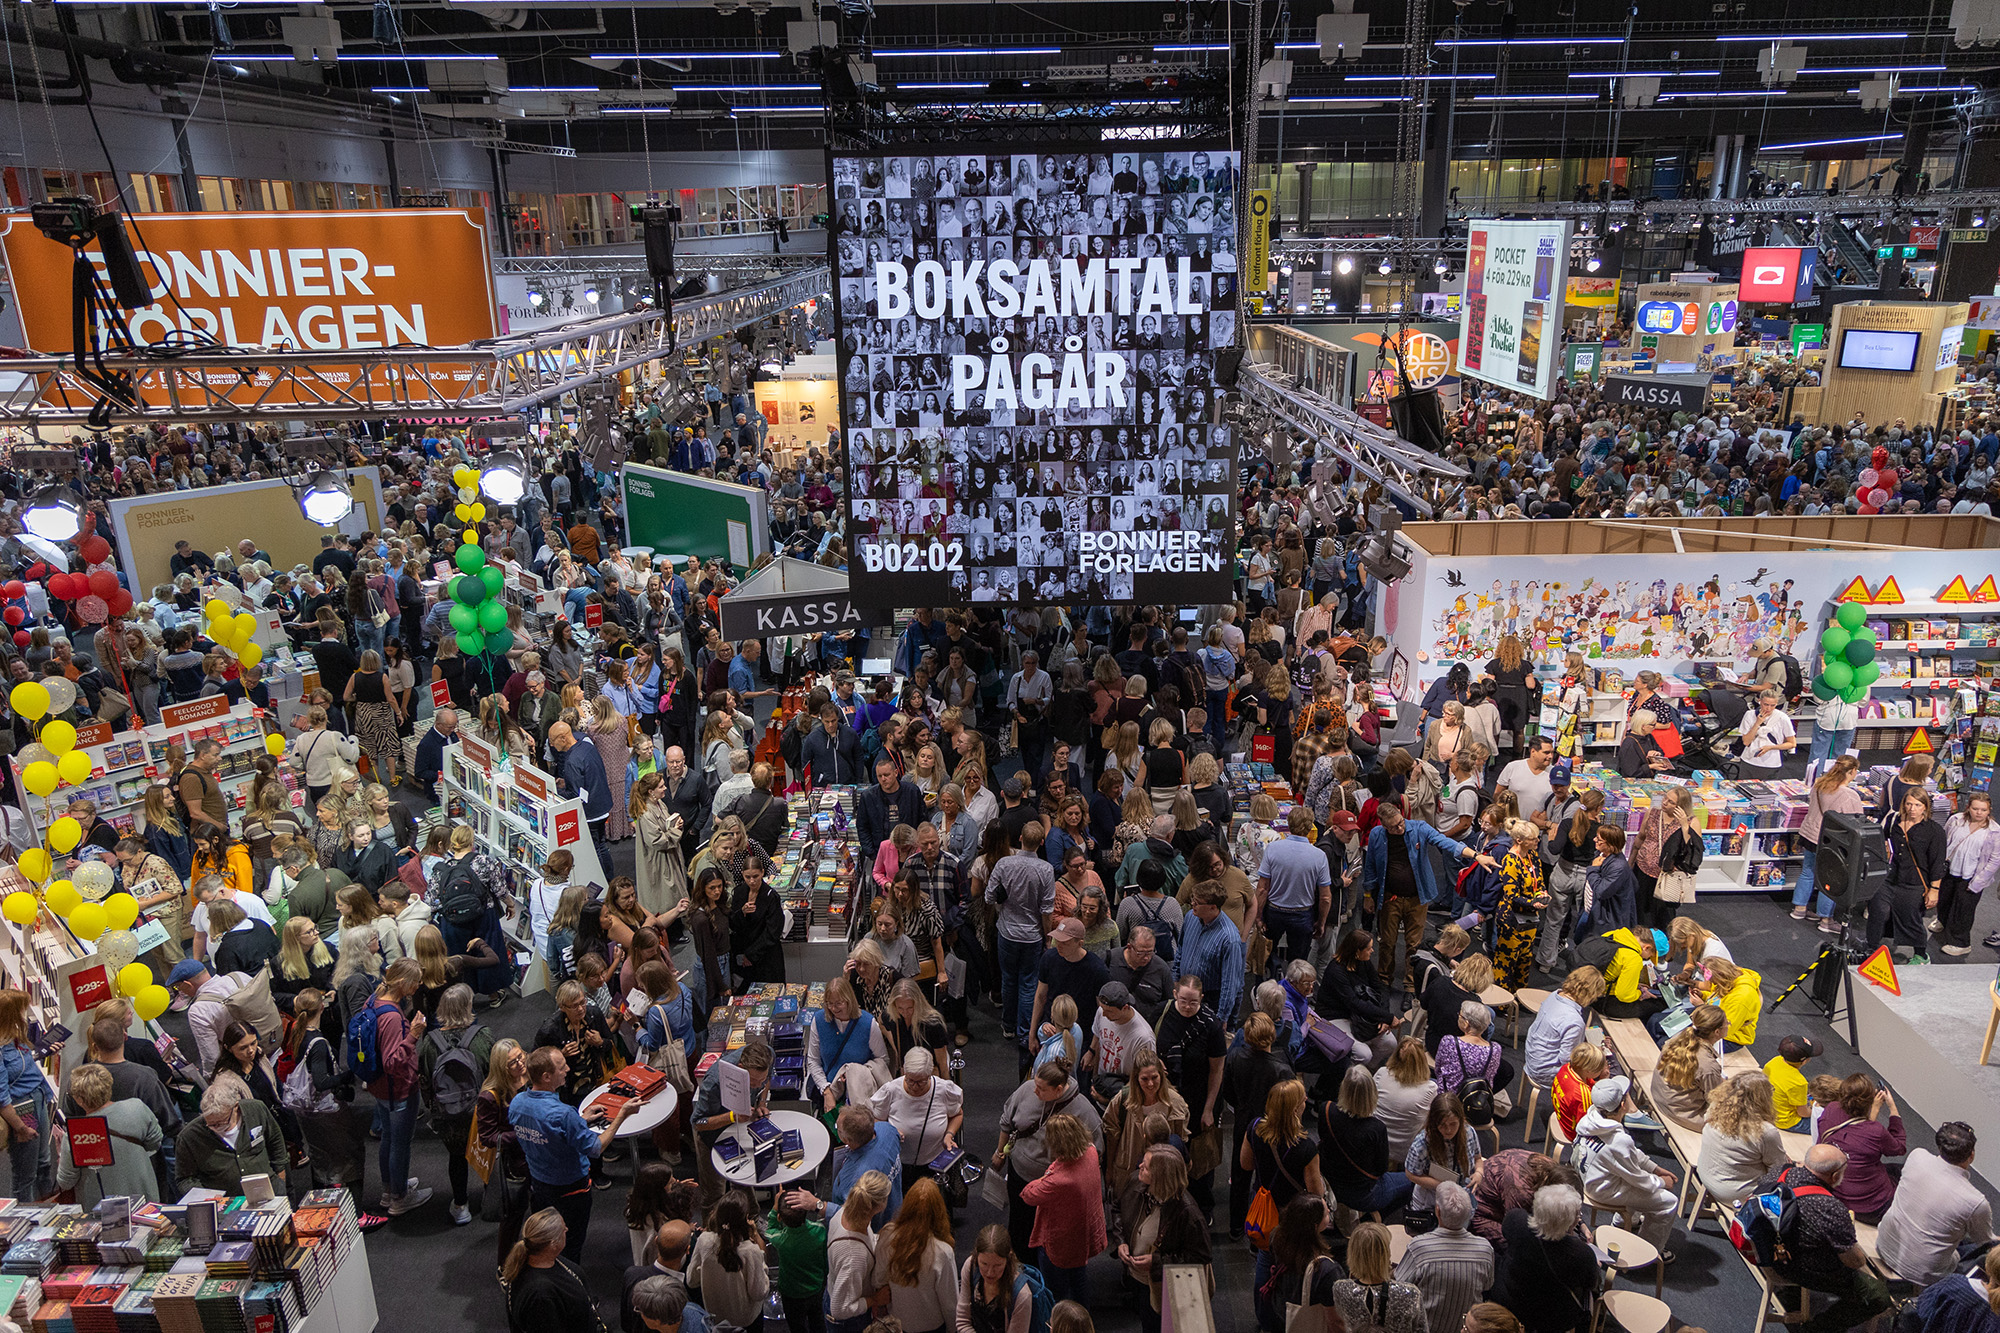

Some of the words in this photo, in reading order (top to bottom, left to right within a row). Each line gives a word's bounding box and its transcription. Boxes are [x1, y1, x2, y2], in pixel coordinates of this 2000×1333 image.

[1253, 218, 1264, 247] förlag
[1494, 247, 1526, 265] POCKET
[1252, 248, 1261, 286] Ordfront
[1485, 268, 1491, 282] 4
[1491, 267, 1505, 285] FÖR
[876, 256, 1203, 319] BOKSAMTAL
[1472, 298, 1486, 364] HYPER
[953, 335, 1127, 410] PÅGÅR
[1621, 384, 1683, 407] KASSA
[1237, 444, 1264, 463] ASS
[628, 478, 653, 489] BONNIER-
[628, 485, 656, 499] FÖRLAGEN
[136, 507, 189, 521] BONNIER-
[138, 514, 195, 529] FÖRLAGEN
[1079, 530, 1212, 552] BONNIER-
[1079, 552, 1221, 574] FÖRLAGEN
[756, 600, 862, 633] KASSA
[173, 701, 213, 716] FEELGOOD
[179, 708, 216, 721] ROMANCE
[466, 743, 487, 761] SPÄNNING
[519, 773, 542, 792] SPÄNNING
[75, 980, 105, 996] 229:-
[73, 1133, 106, 1145] 229:-
[156, 1276, 176, 1296] KYSS
[179, 1274, 199, 1295] HEJDÅ
